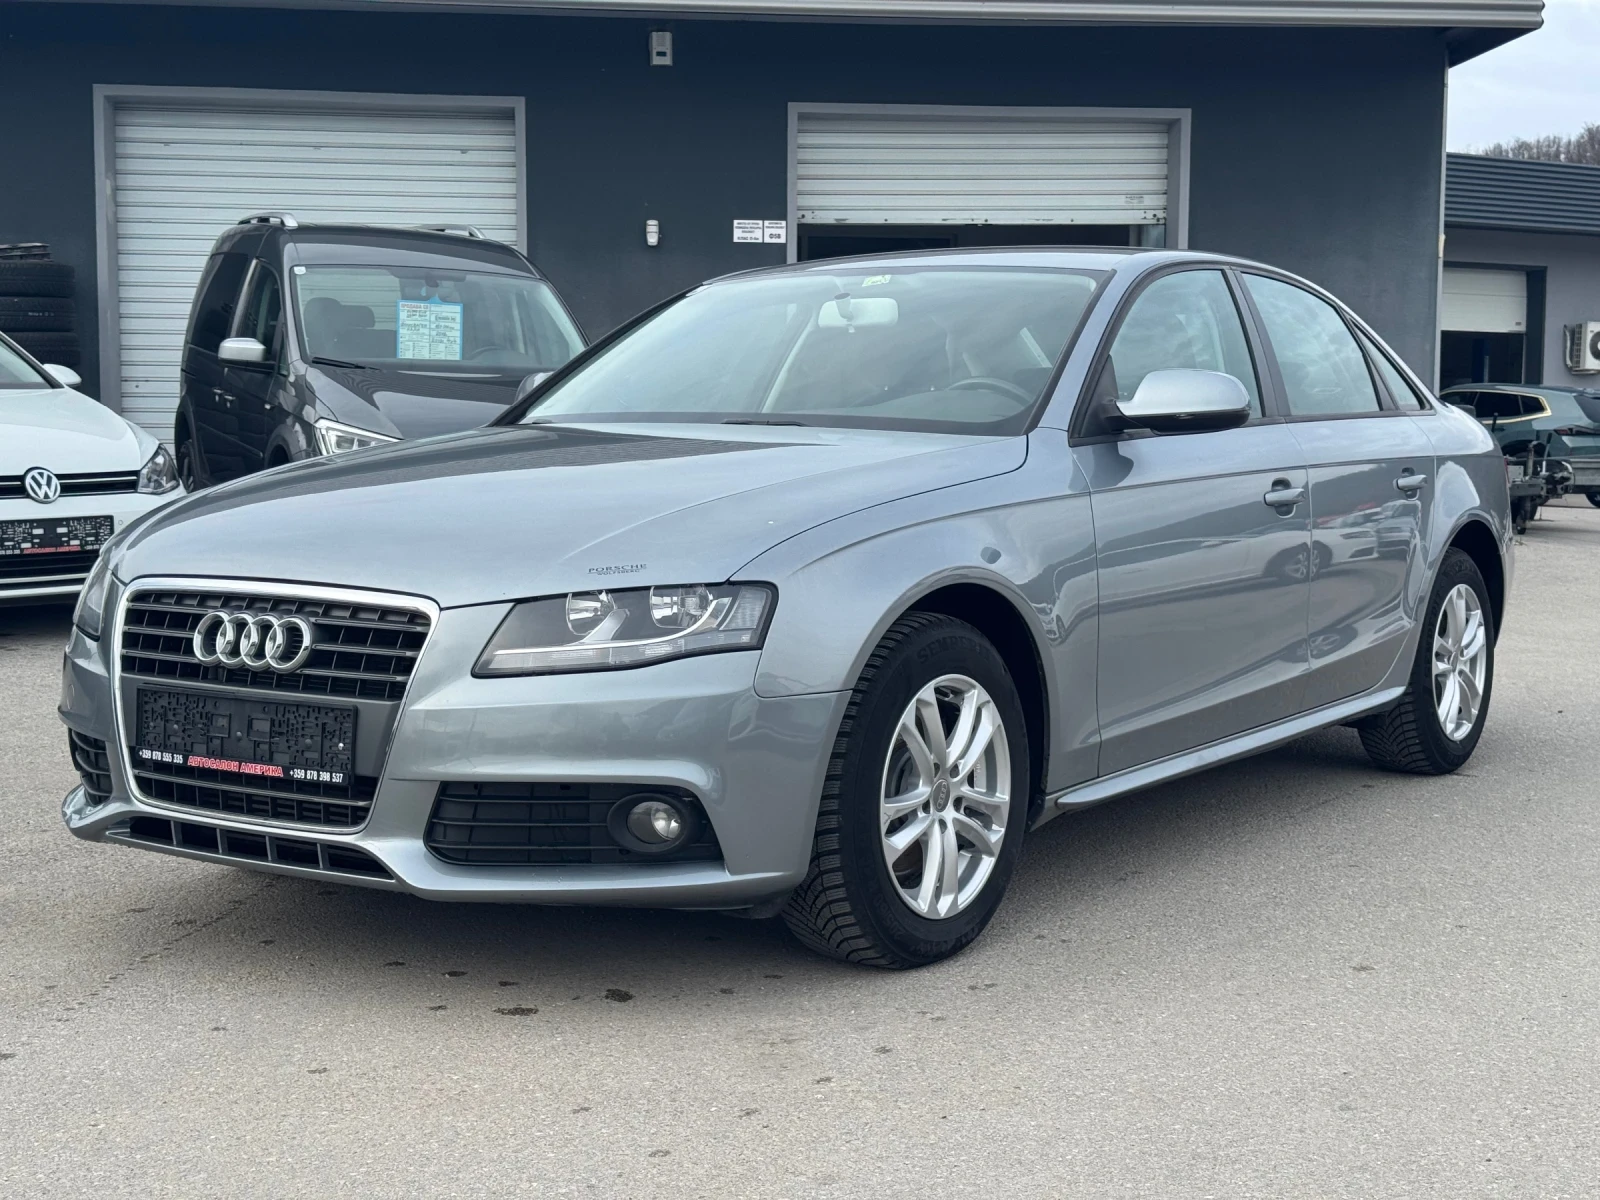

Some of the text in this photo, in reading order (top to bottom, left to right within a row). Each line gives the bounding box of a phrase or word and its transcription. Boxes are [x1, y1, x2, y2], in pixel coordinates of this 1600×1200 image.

[588, 564, 646, 573] PORSCHE
[139, 749, 151, 760] +359
[162, 752, 172, 763] 555
[187, 755, 240, 772] АВТОСАЛОН
[240, 762, 284, 778] АМЕРИКА
[289, 768, 305, 779] +359
[306, 769, 318, 780] 878
[319, 771, 331, 782] 398
[332, 772, 344, 783] 537
